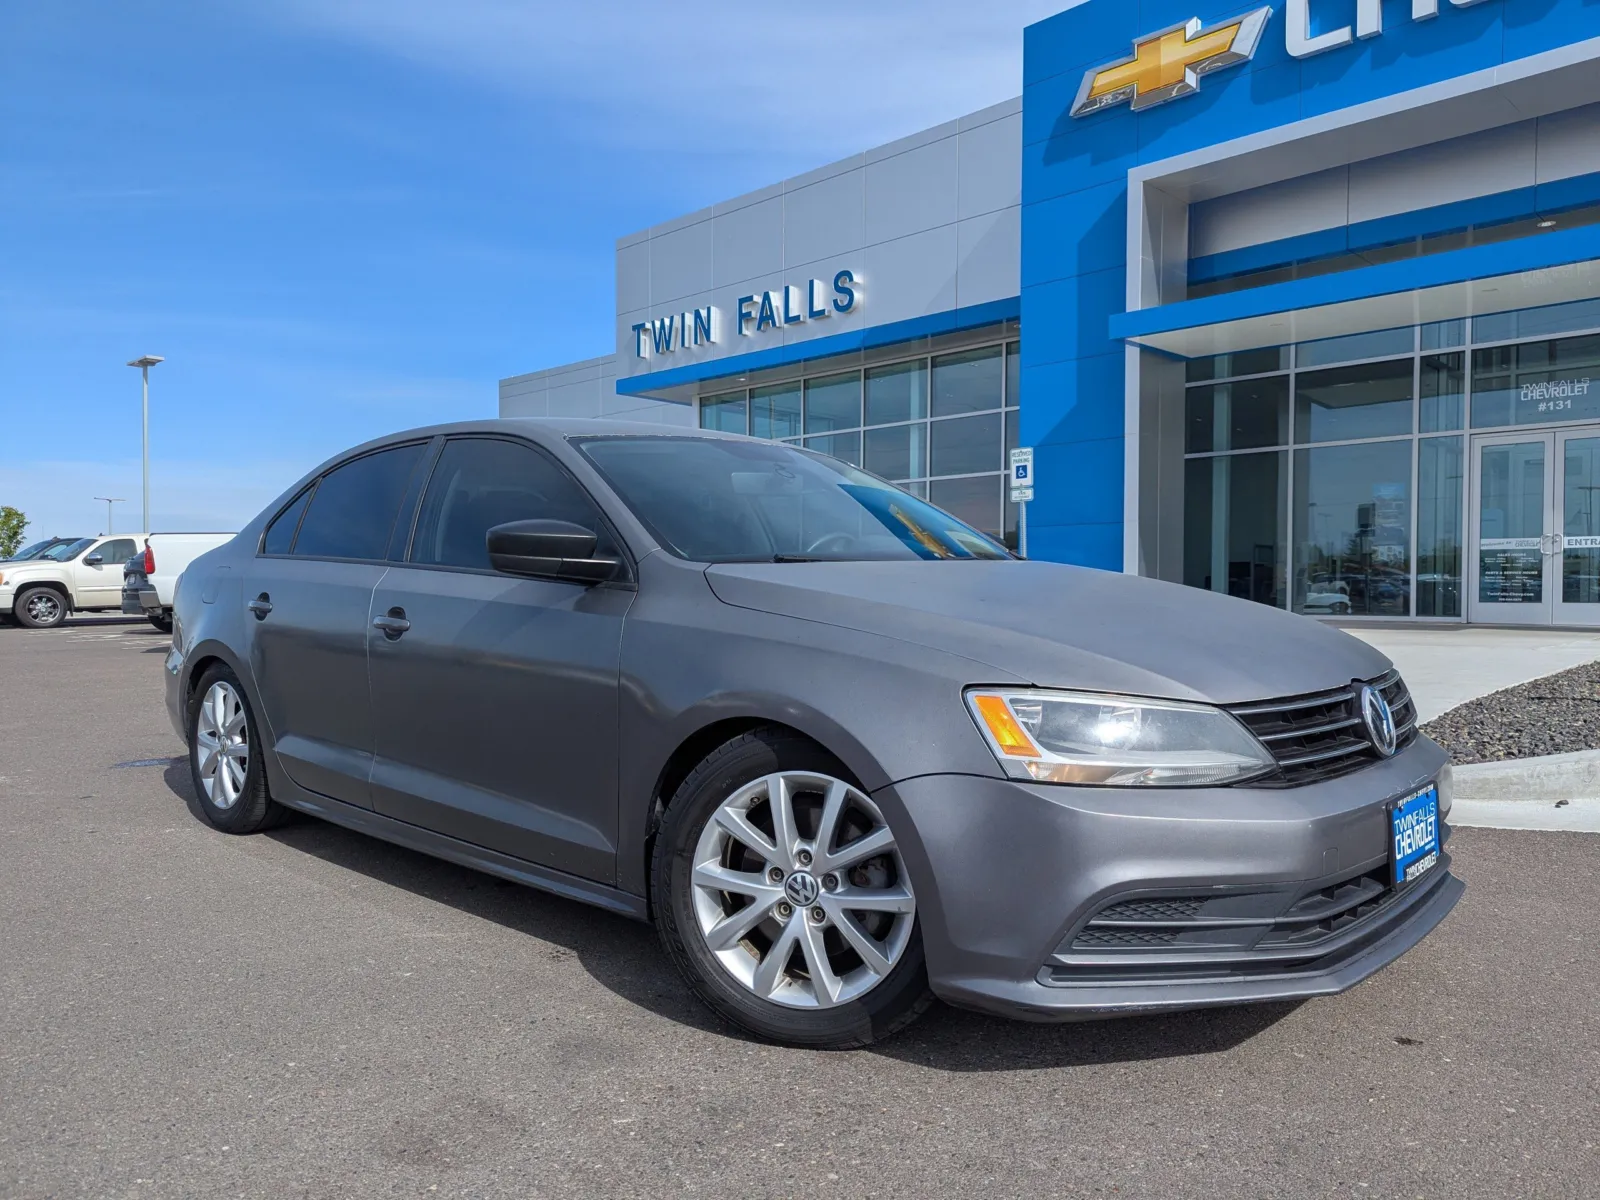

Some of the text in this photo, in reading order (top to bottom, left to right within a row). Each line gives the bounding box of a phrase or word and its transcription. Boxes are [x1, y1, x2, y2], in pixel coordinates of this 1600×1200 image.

[632, 270, 856, 358] TWIN FALLS
[1521, 384, 1589, 401] CHEVROLET
[1538, 400, 1572, 412] #131
[1012, 450, 1032, 458] RESERVED
[1395, 816, 1436, 860] CHEVROLET
